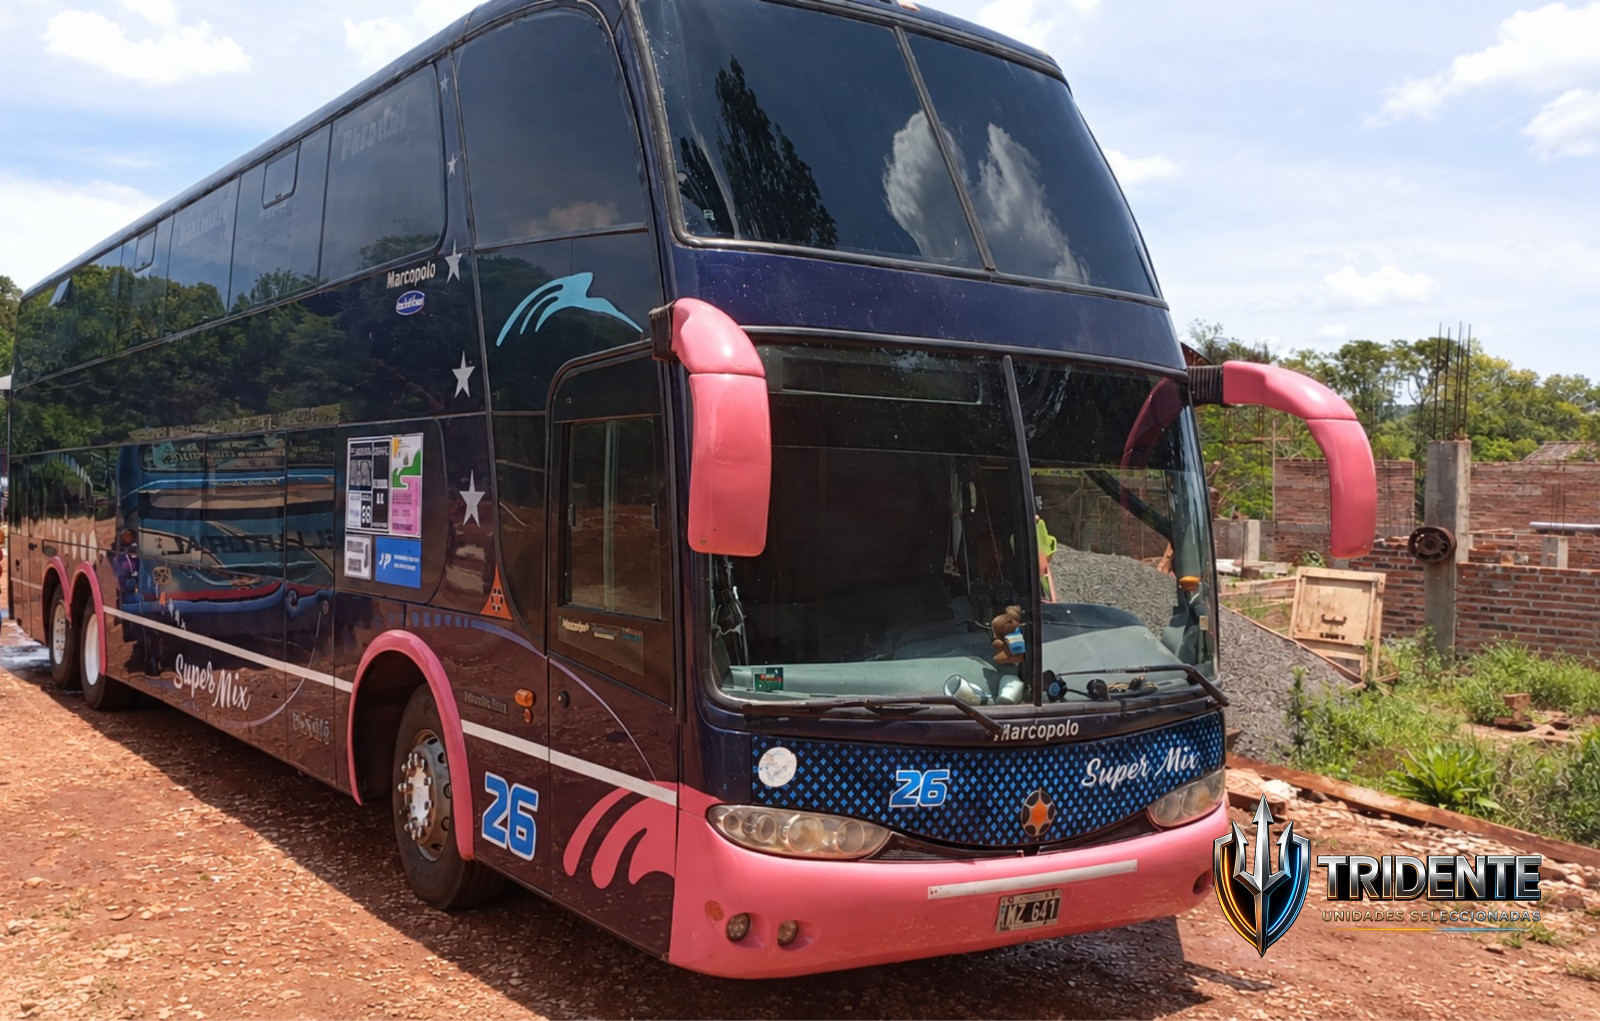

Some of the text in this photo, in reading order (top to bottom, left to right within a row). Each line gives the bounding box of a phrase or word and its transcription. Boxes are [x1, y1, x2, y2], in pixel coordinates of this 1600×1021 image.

[386, 260, 436, 289] Marcopolo
[173, 653, 250, 711] Super Mix
[1000, 719, 1080, 742] Marcopolo
[1081, 746, 1200, 790] Super Mix
[889, 769, 950, 808] 26
[481, 771, 539, 861] 26
[1031, 899, 1056, 922] 641
